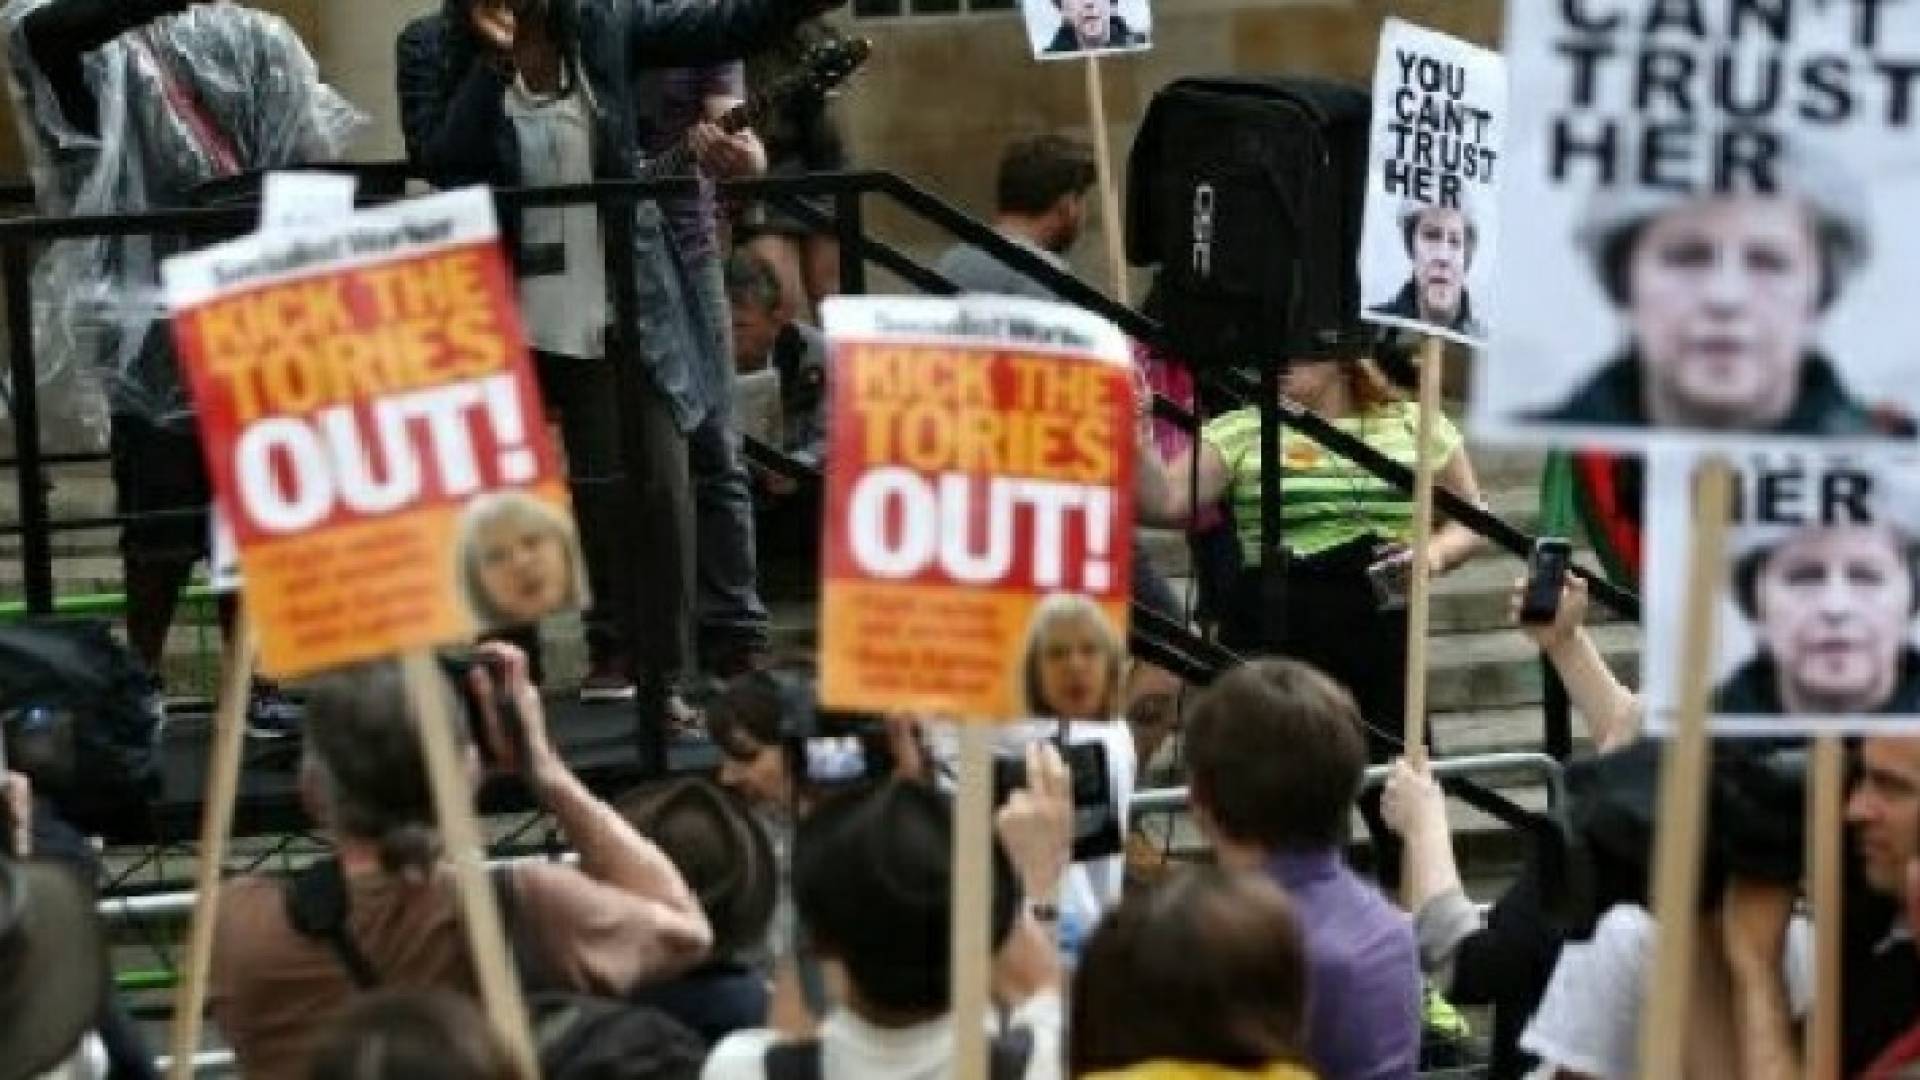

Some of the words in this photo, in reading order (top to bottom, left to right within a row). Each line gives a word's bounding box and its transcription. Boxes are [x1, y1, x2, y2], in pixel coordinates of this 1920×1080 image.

[1396, 49, 1464, 100] YOU
[1552, 40, 1920, 128] TRUST
[1384, 159, 1462, 209] HER
[1388, 123, 1497, 184] TRUST
[1549, 116, 1779, 193] HER
[203, 271, 348, 361] KICK
[371, 252, 492, 322] THE
[210, 318, 505, 424] TORIES
[858, 344, 993, 404] KICK
[1014, 358, 1114, 412] THE
[236, 374, 539, 533] OUT!
[859, 402, 1112, 483] TORIES
[850, 467, 1111, 591] OUT!
